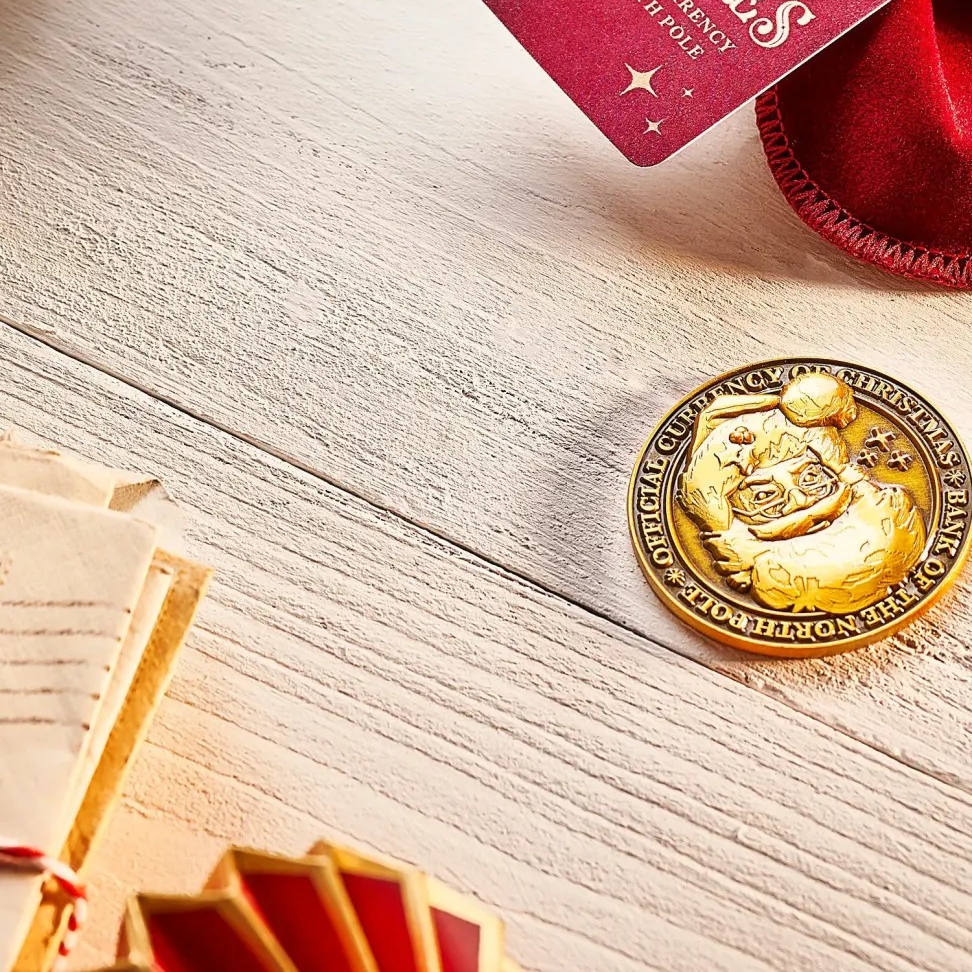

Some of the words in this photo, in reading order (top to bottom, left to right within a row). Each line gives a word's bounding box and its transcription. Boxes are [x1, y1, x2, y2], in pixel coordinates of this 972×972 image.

[659, 12, 705, 61] POLE
[636, 459, 669, 568] OFFICIAL
[838, 369, 963, 468] CHRISTMAS
[936, 489, 968, 559] BANK
[911, 558, 947, 592] OF
[682, 583, 749, 633] POLE
[753, 614, 858, 641] NORTH
[864, 586, 918, 627] THE
